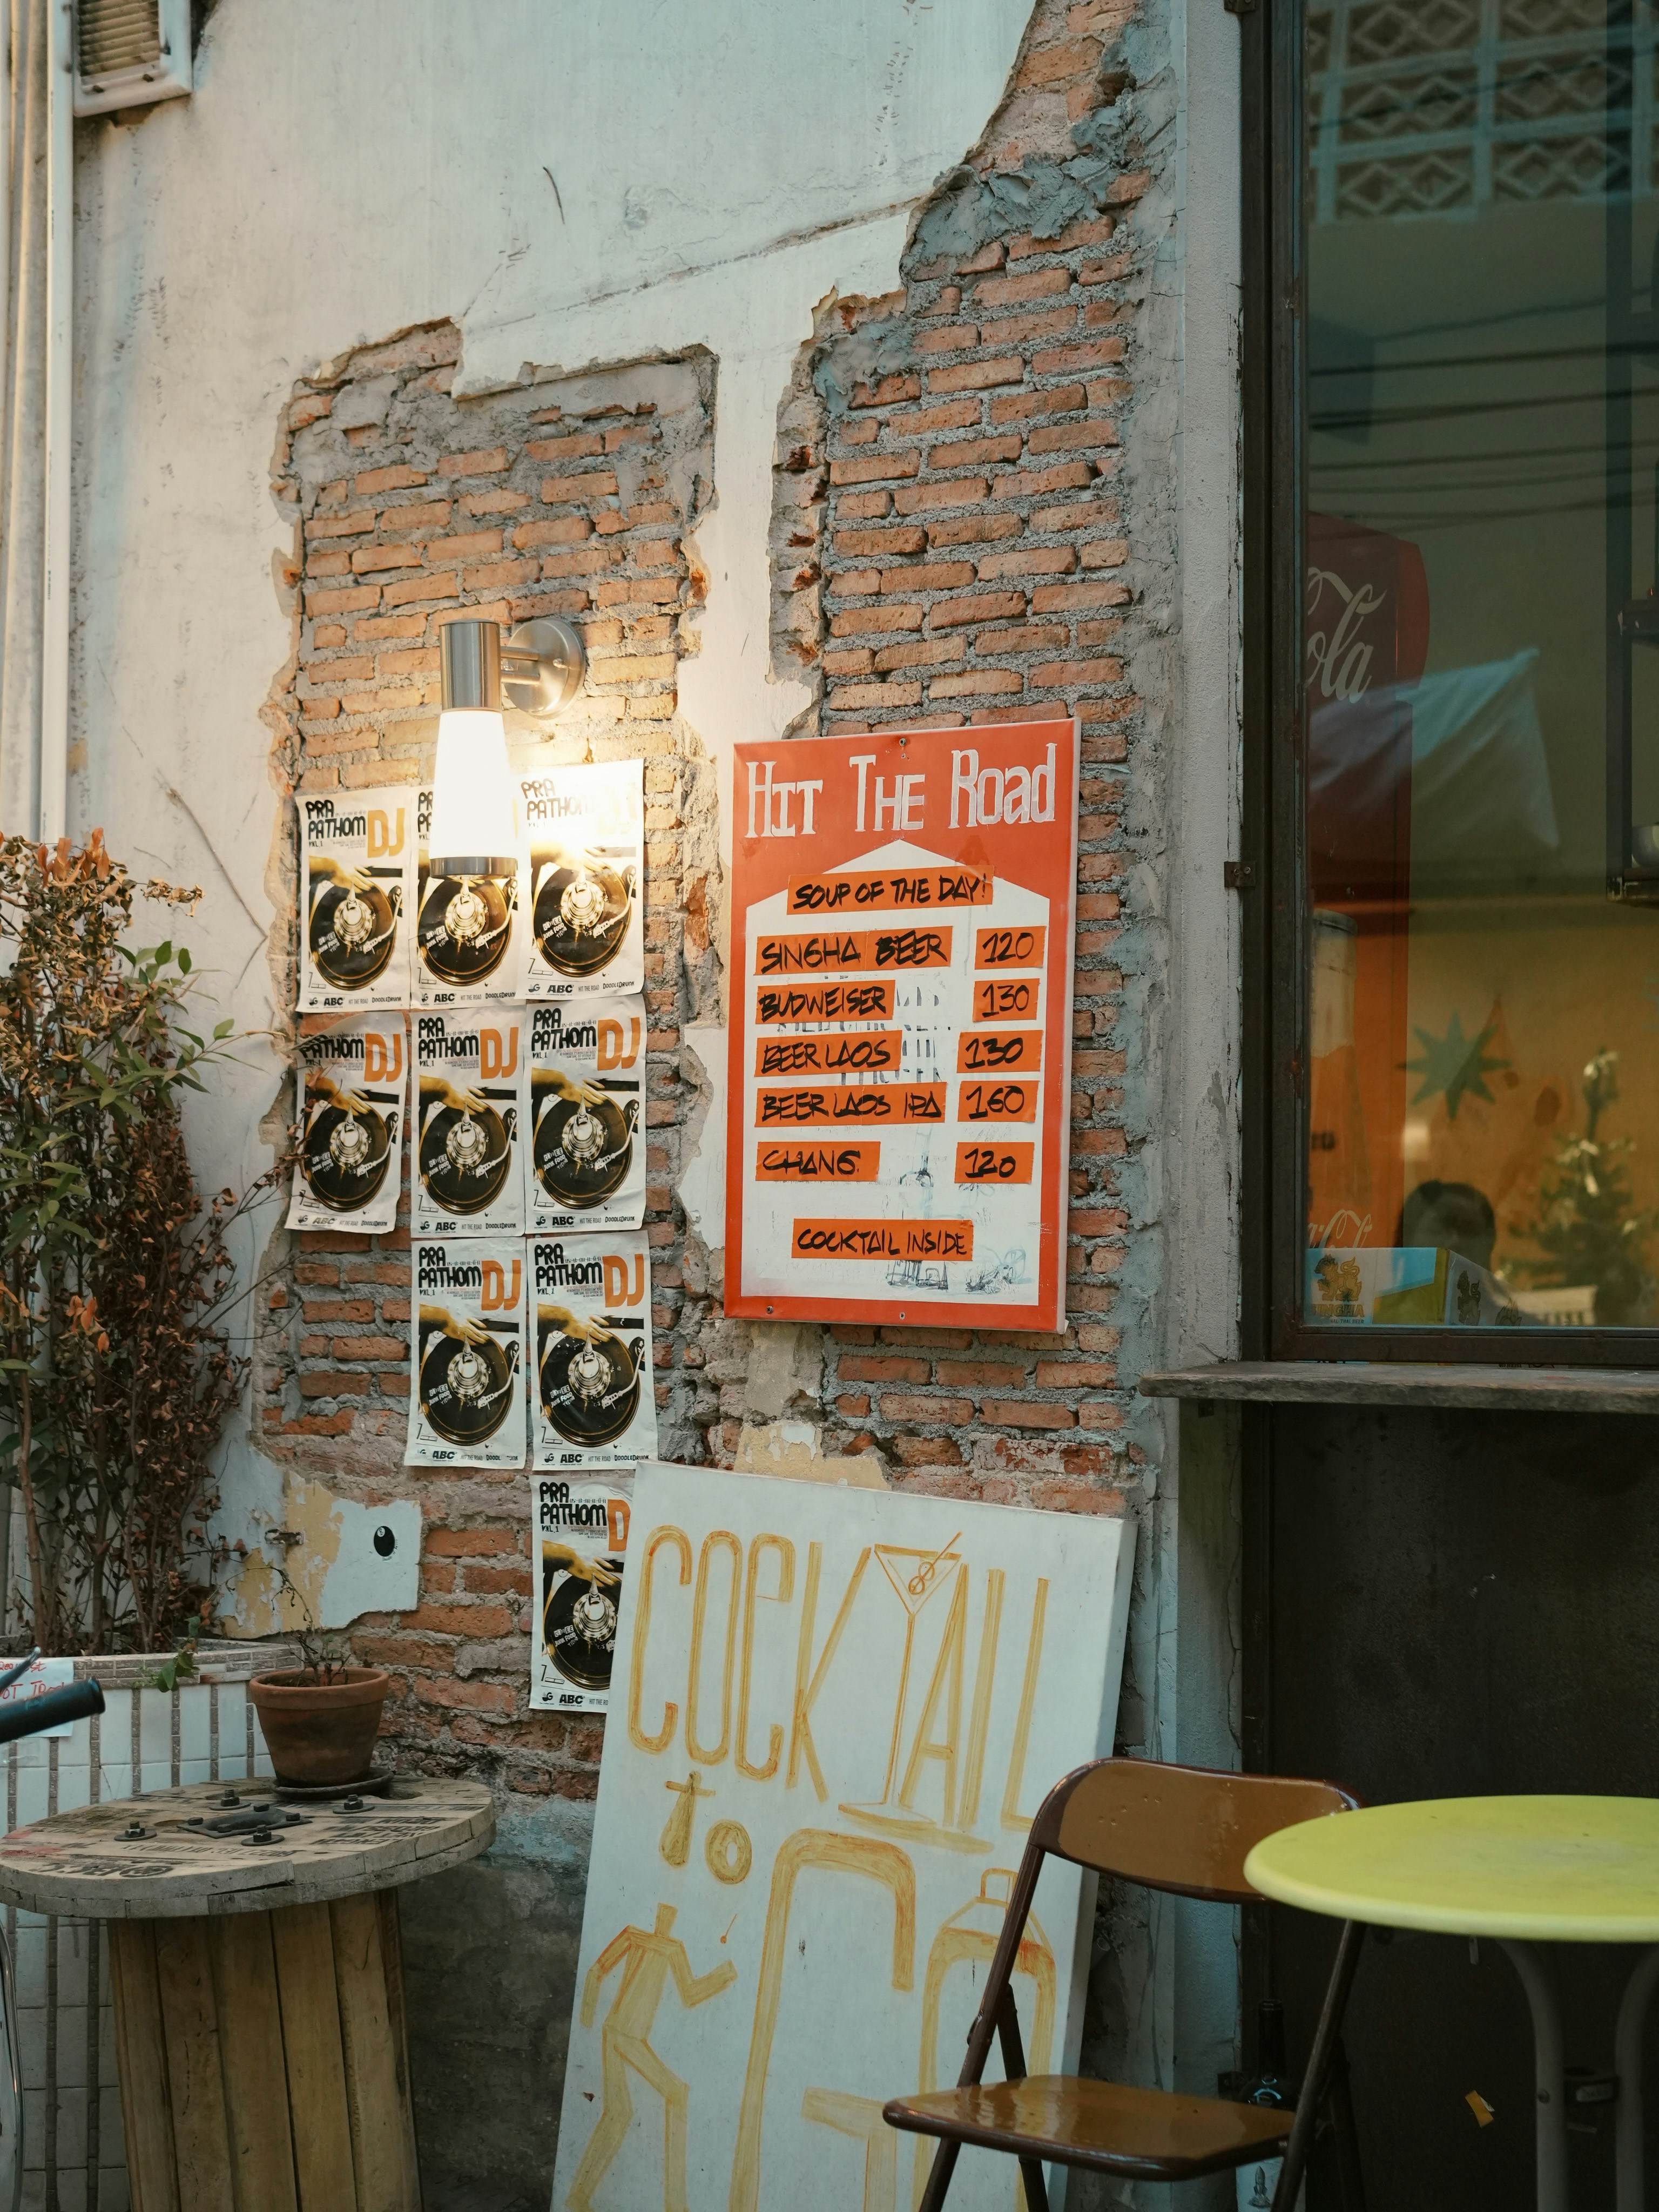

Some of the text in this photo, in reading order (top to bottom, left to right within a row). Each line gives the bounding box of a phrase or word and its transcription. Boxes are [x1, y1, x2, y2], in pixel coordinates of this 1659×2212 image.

[521, 778, 556, 799] PRA
[745, 743, 1057, 838] HIT THE Road
[306, 800, 334, 819] PRA
[418, 791, 433, 812] PR
[308, 816, 366, 839] PATHOM
[367, 808, 405, 858] DJ
[793, 872, 988, 909] SOUP OF THE DAY!
[554, 922, 565, 933] FOOD
[761, 930, 948, 974] SINGHA BEER
[983, 932, 1034, 963] 120
[758, 986, 886, 1022] BUDWEISER
[982, 983, 1029, 1017] 130
[419, 1017, 444, 1038] PRA
[533, 1008, 561, 1030] PRA
[419, 1035, 479, 1059] PATHOM
[531, 1026, 597, 1051] PATHOM
[597, 1017, 640, 1071] DJ
[364, 1034, 402, 1082] DJ
[480, 1027, 519, 1079] DJ
[761, 1040, 891, 1074] BEER LAOS
[965, 1038, 1023, 1069] 130
[761, 1091, 942, 1122] BEER LAOS IPA
[966, 1085, 1024, 1120] 160
[439, 1161, 449, 1171] FOOD
[554, 1154, 566, 1164] FOOD
[965, 1148, 1016, 1178] 120
[535, 1243, 564, 1265] PRA
[797, 1228, 967, 1256] COCKTAIL INSIDE
[419, 1246, 446, 1267] PRA
[419, 1266, 482, 1288] PATHOM
[481, 1259, 521, 1311] DJ
[536, 1262, 603, 1287] PATHOM
[602, 1253, 644, 1307] DJ
[439, 1391, 450, 1400] FOOD
[560, 1391, 572, 1401] FOOD
[539, 1482, 569, 1503] PRA
[540, 1503, 607, 1526] PATHOM
[608, 1499, 631, 1552] D
[564, 1632, 576, 1641] FOOD
